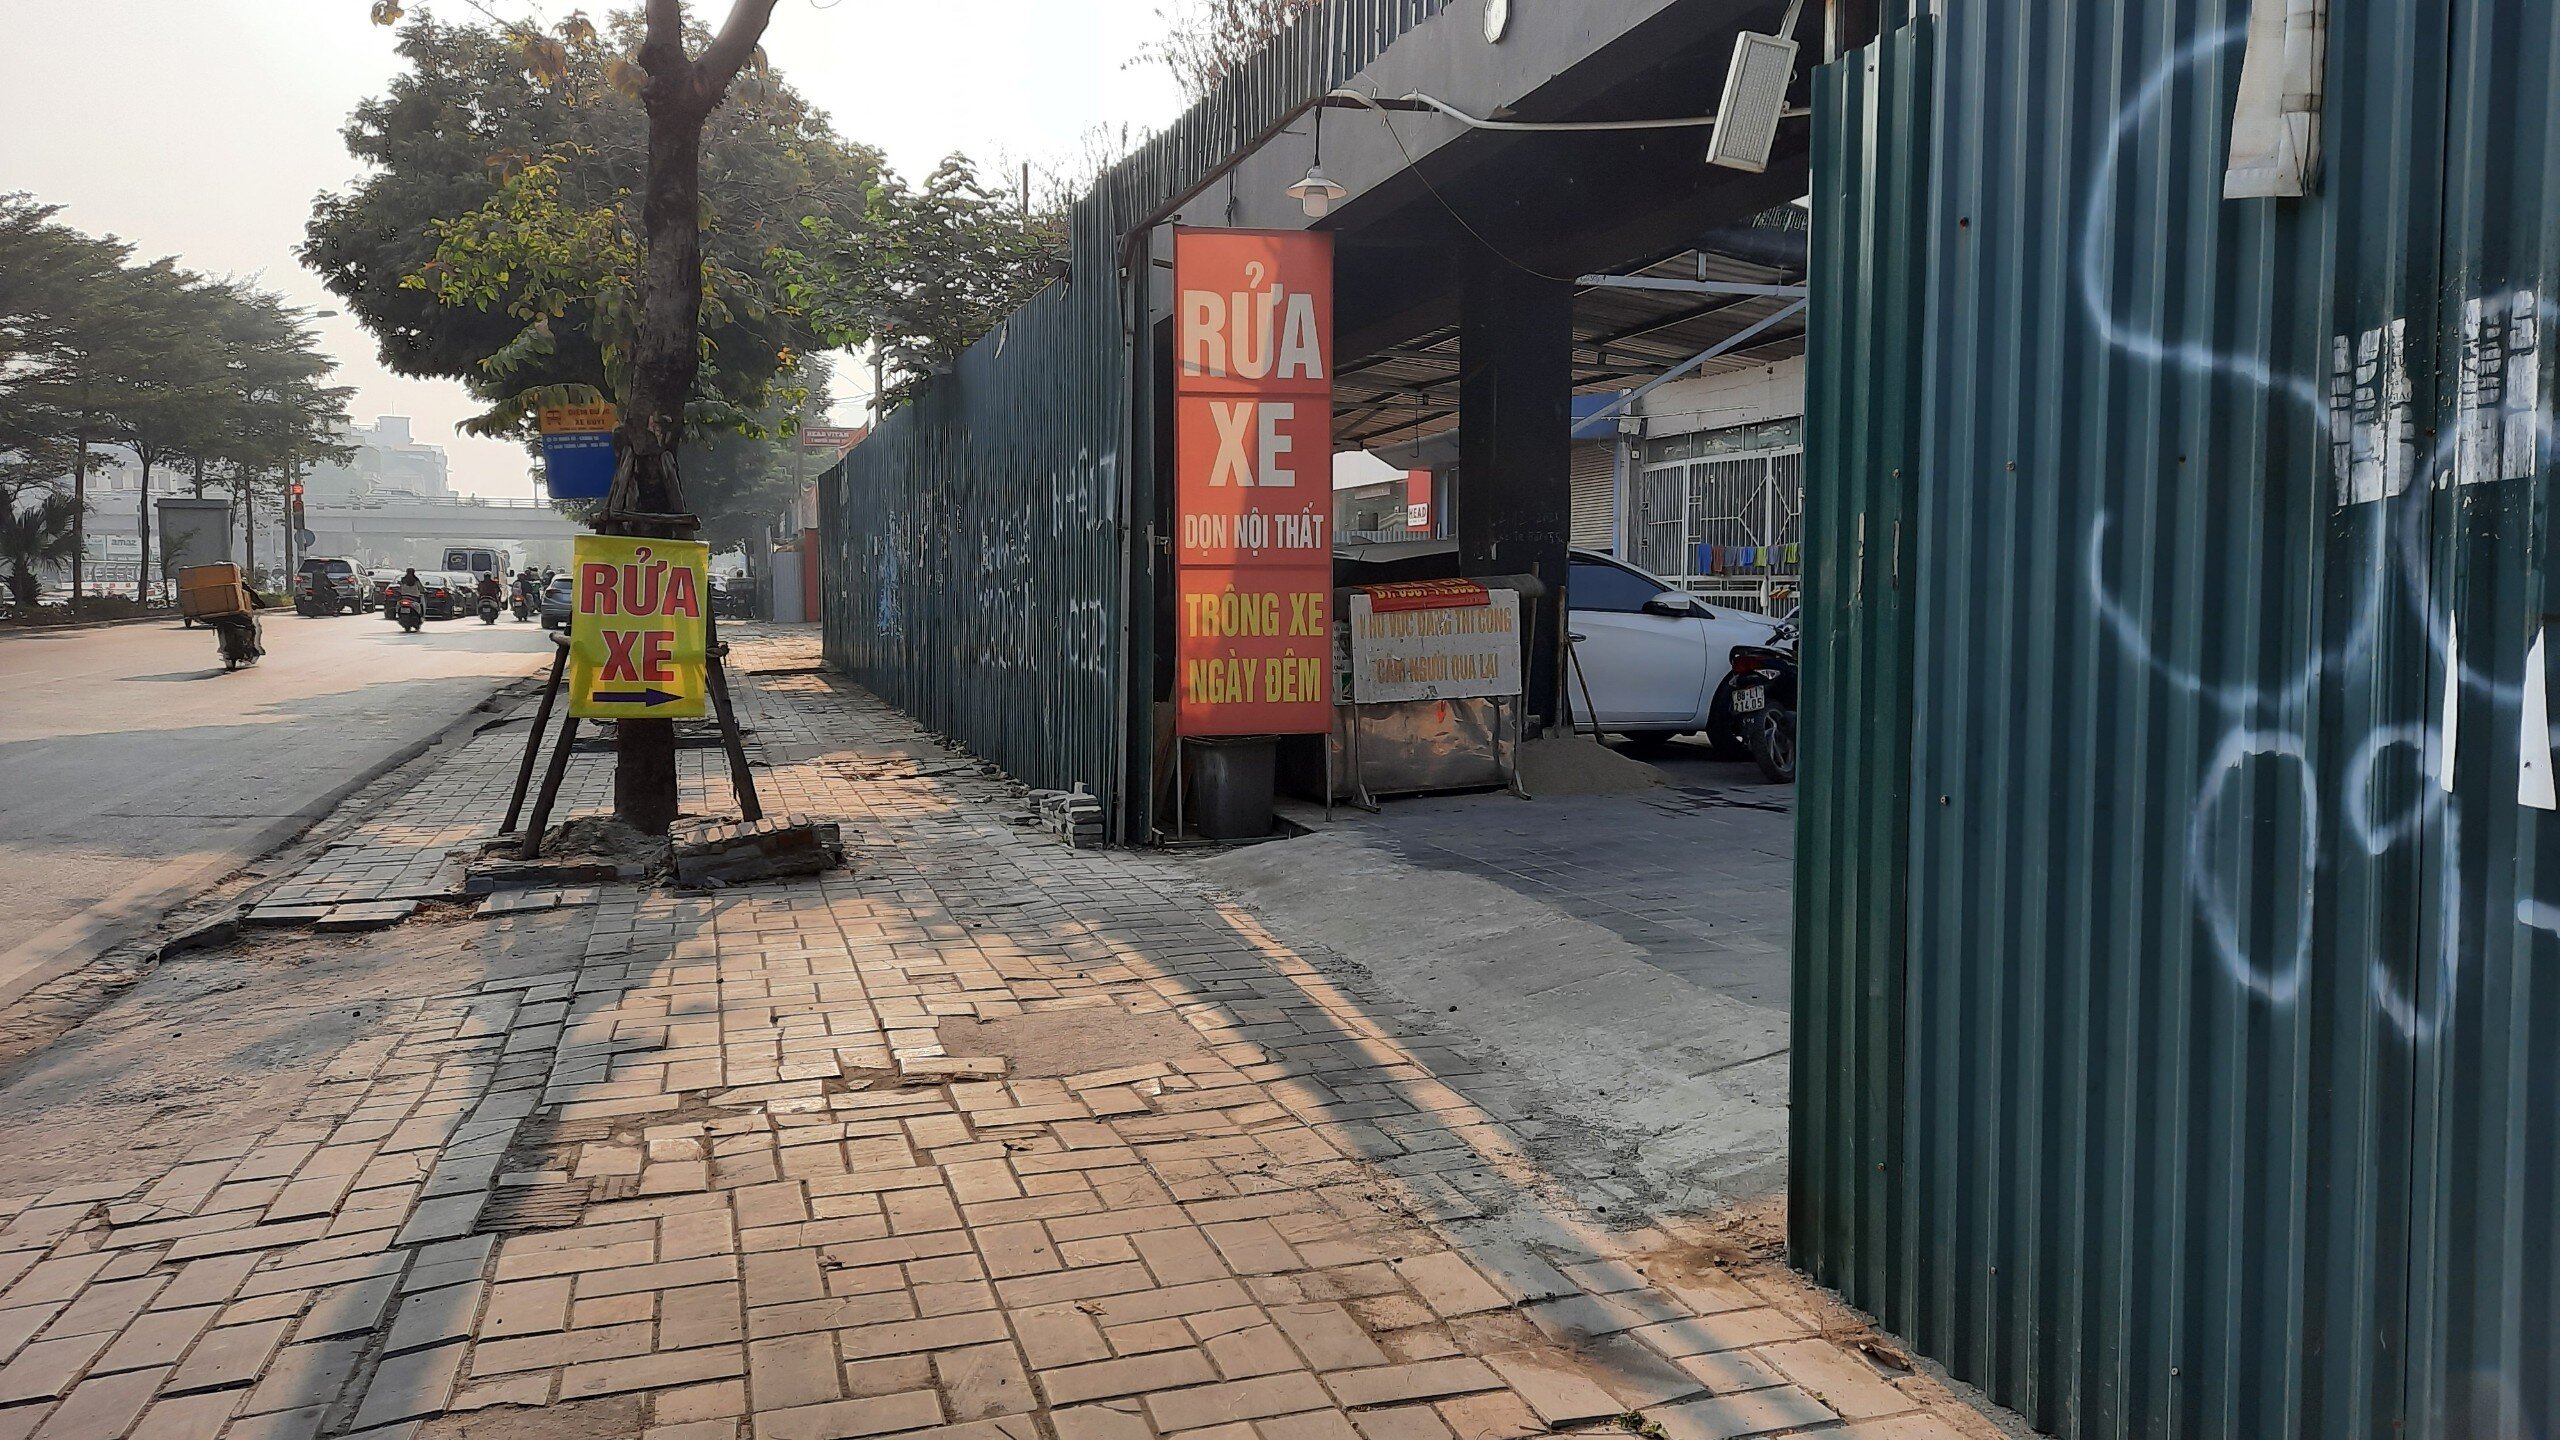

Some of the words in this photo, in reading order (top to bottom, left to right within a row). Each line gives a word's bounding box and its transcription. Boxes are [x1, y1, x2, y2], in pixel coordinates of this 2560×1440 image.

[1183, 260, 1324, 379] RỬA
[1208, 401, 1296, 487] XE
[1184, 514, 1227, 557] DỌN
[1233, 506, 1269, 557] NỘI
[1275, 501, 1324, 549] THẤT
[1409, 506, 1426, 518] HEAD
[580, 546, 701, 618] RỬA
[1185, 583, 1280, 637] TRÔNG
[1289, 592, 1324, 637] XE
[599, 630, 675, 682] XE
[1189, 648, 1258, 704] NGÀY
[1265, 647, 1321, 703] ĐÊM
[1452, 655, 1476, 681] QUA
